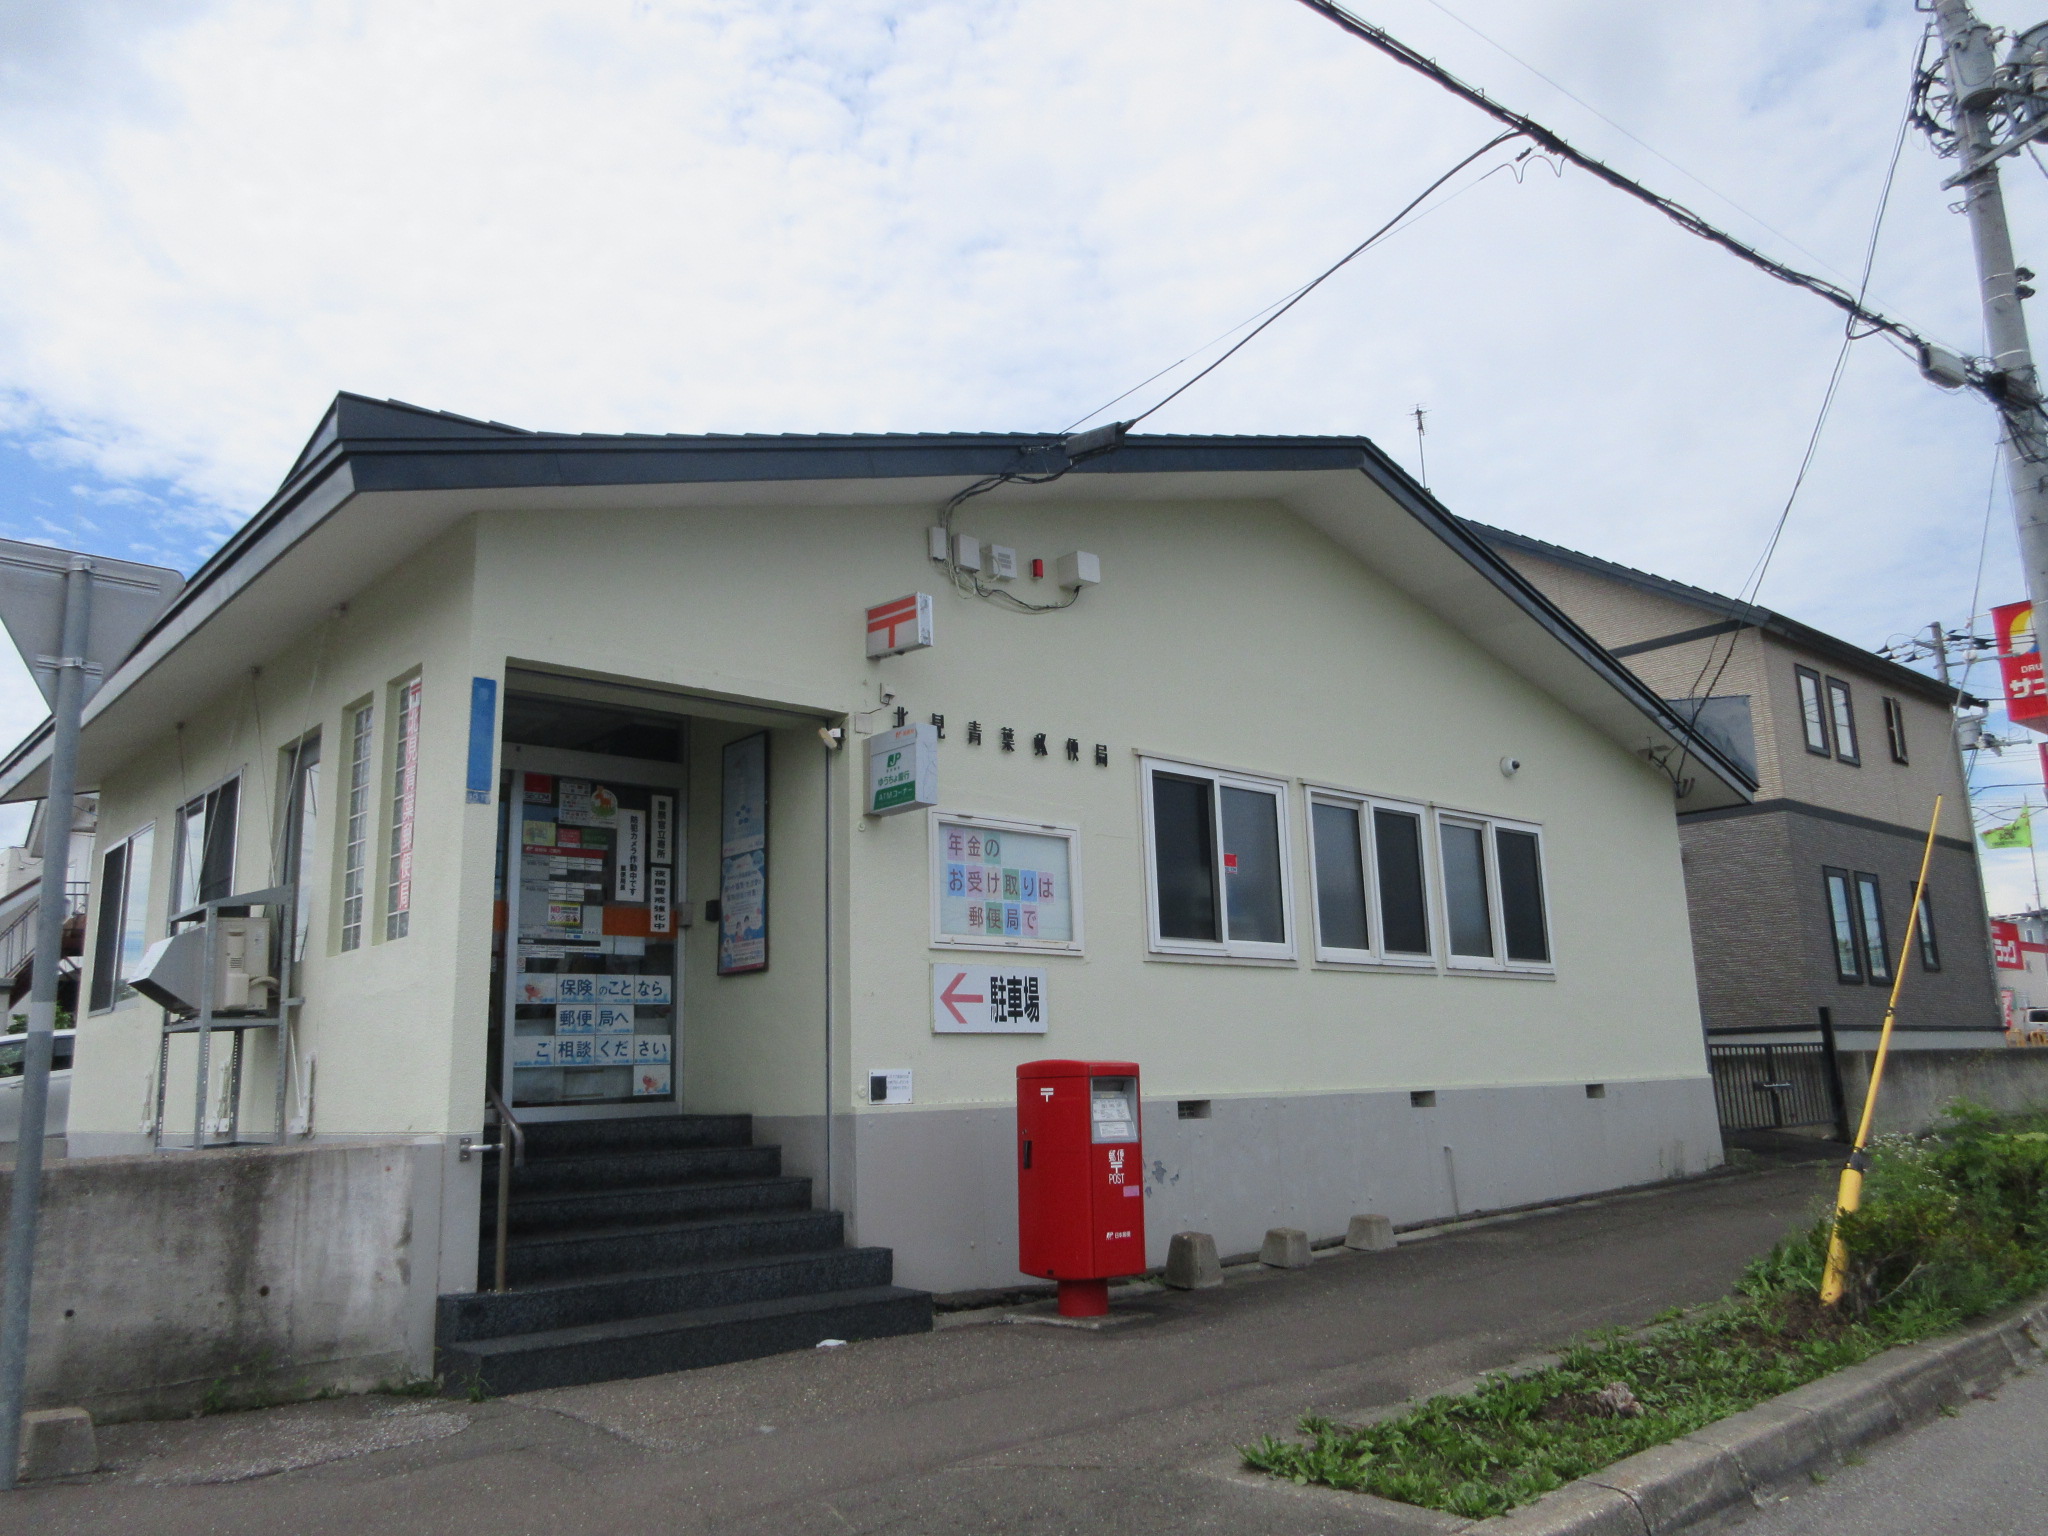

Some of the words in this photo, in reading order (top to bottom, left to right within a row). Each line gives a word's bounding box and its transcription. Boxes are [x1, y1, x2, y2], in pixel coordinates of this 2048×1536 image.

[893, 706, 1108, 768] 北見青葉郵便局
[629, 815, 639, 896] 防犯カメラ作動中です
[948, 832, 1000, 858] 年金の
[949, 868, 1054, 898] お受け取りは
[654, 870, 666, 930] 夜間警戒強化中
[968, 906, 1037, 930] 郵便局で
[560, 979, 663, 996] 保険のことなら
[990, 975, 1040, 1023] 駐車場
[560, 1010, 629, 1027] 郵便局へ
[536, 1040, 667, 1058] ご相談ください
[1108, 1149, 1125, 1162] 郵便
[1108, 1173, 1125, 1184] POST
